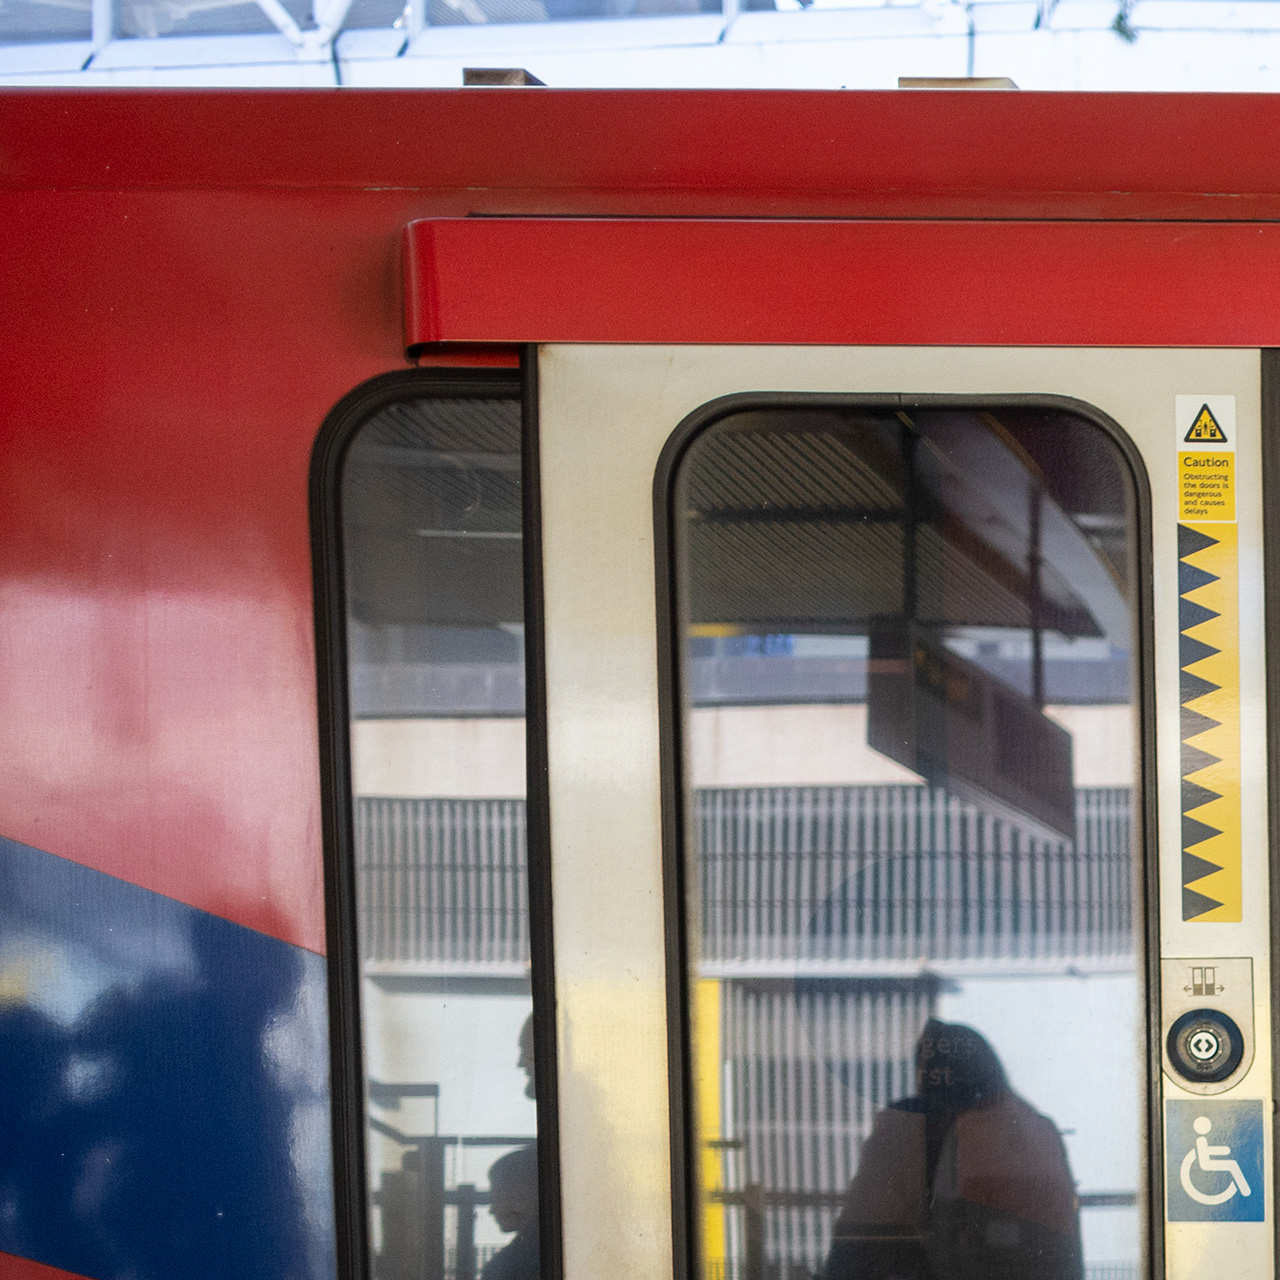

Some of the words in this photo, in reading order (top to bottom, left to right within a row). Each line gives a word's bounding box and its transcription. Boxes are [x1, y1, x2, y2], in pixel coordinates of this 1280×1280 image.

[1183, 456, 1229, 467] Caution
[1183, 473, 1228, 481] Obstructing
[1183, 490, 1222, 498] dangerous
[1183, 507, 1208, 515] delays
